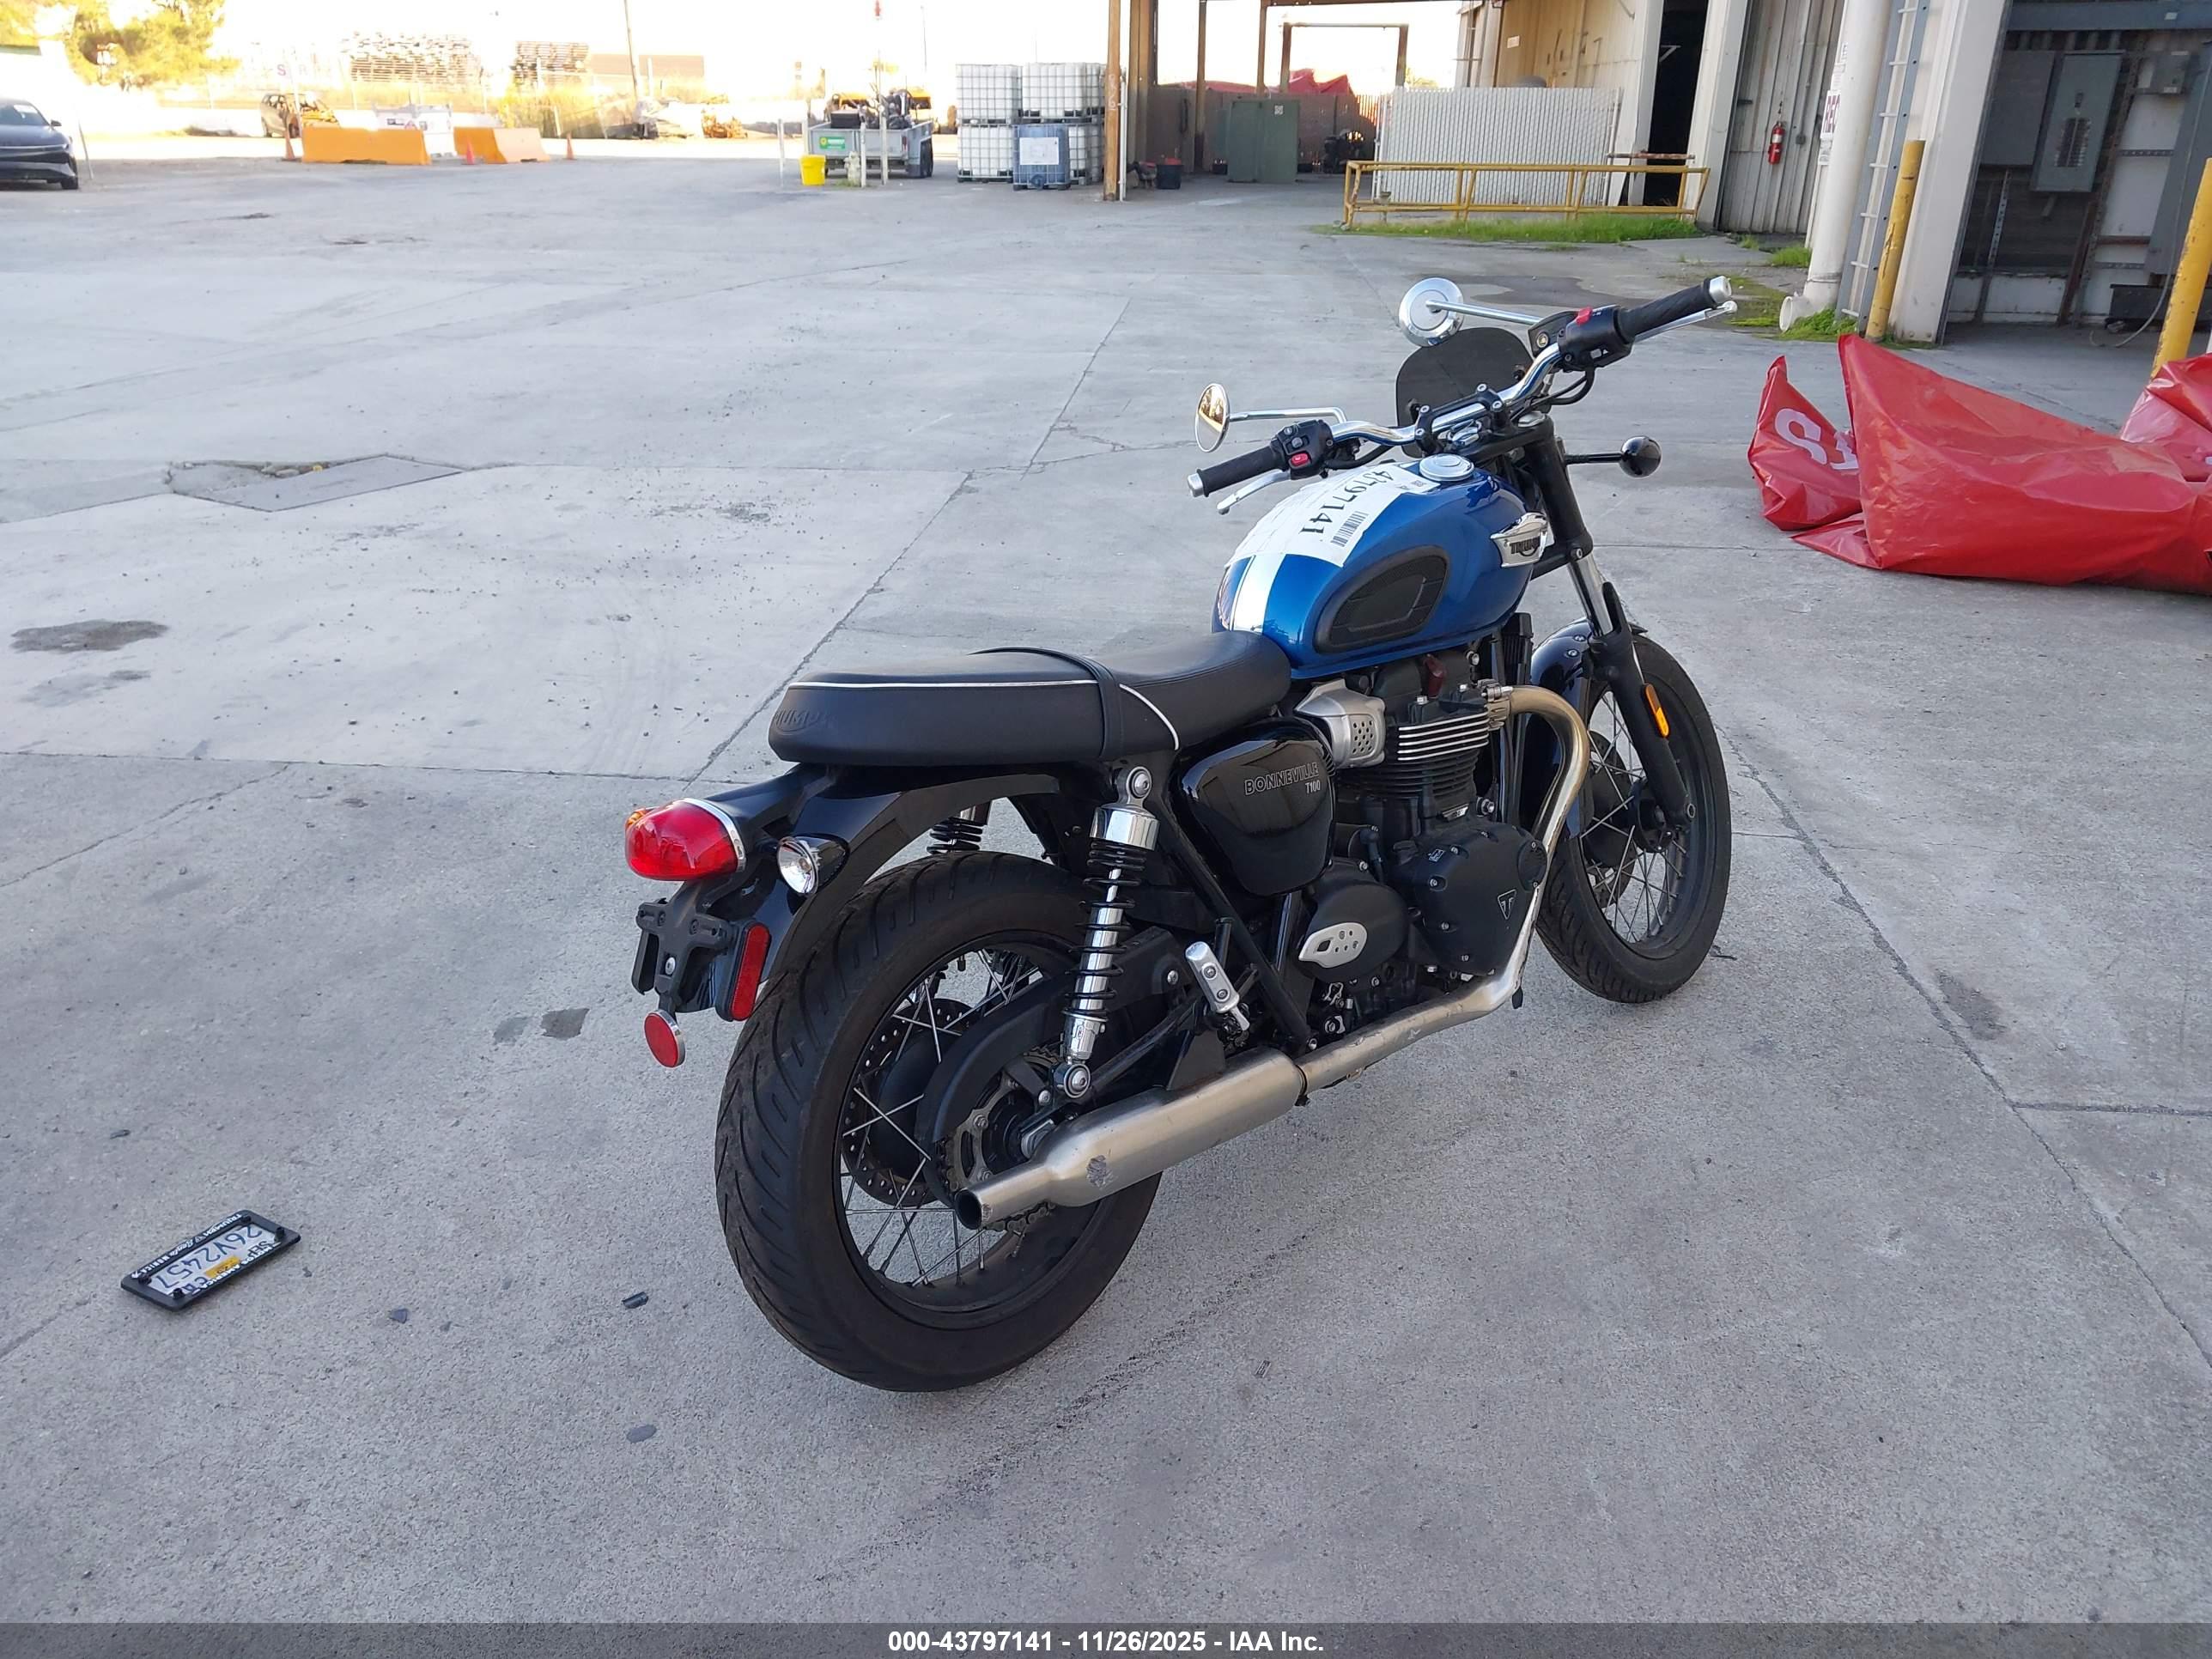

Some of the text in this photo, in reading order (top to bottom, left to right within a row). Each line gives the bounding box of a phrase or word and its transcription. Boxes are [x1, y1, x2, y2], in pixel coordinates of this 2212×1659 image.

[1298, 470, 1394, 534] 43797141
[1244, 762, 1320, 796] BONNEVILLE
[1304, 780, 1321, 794] T100
